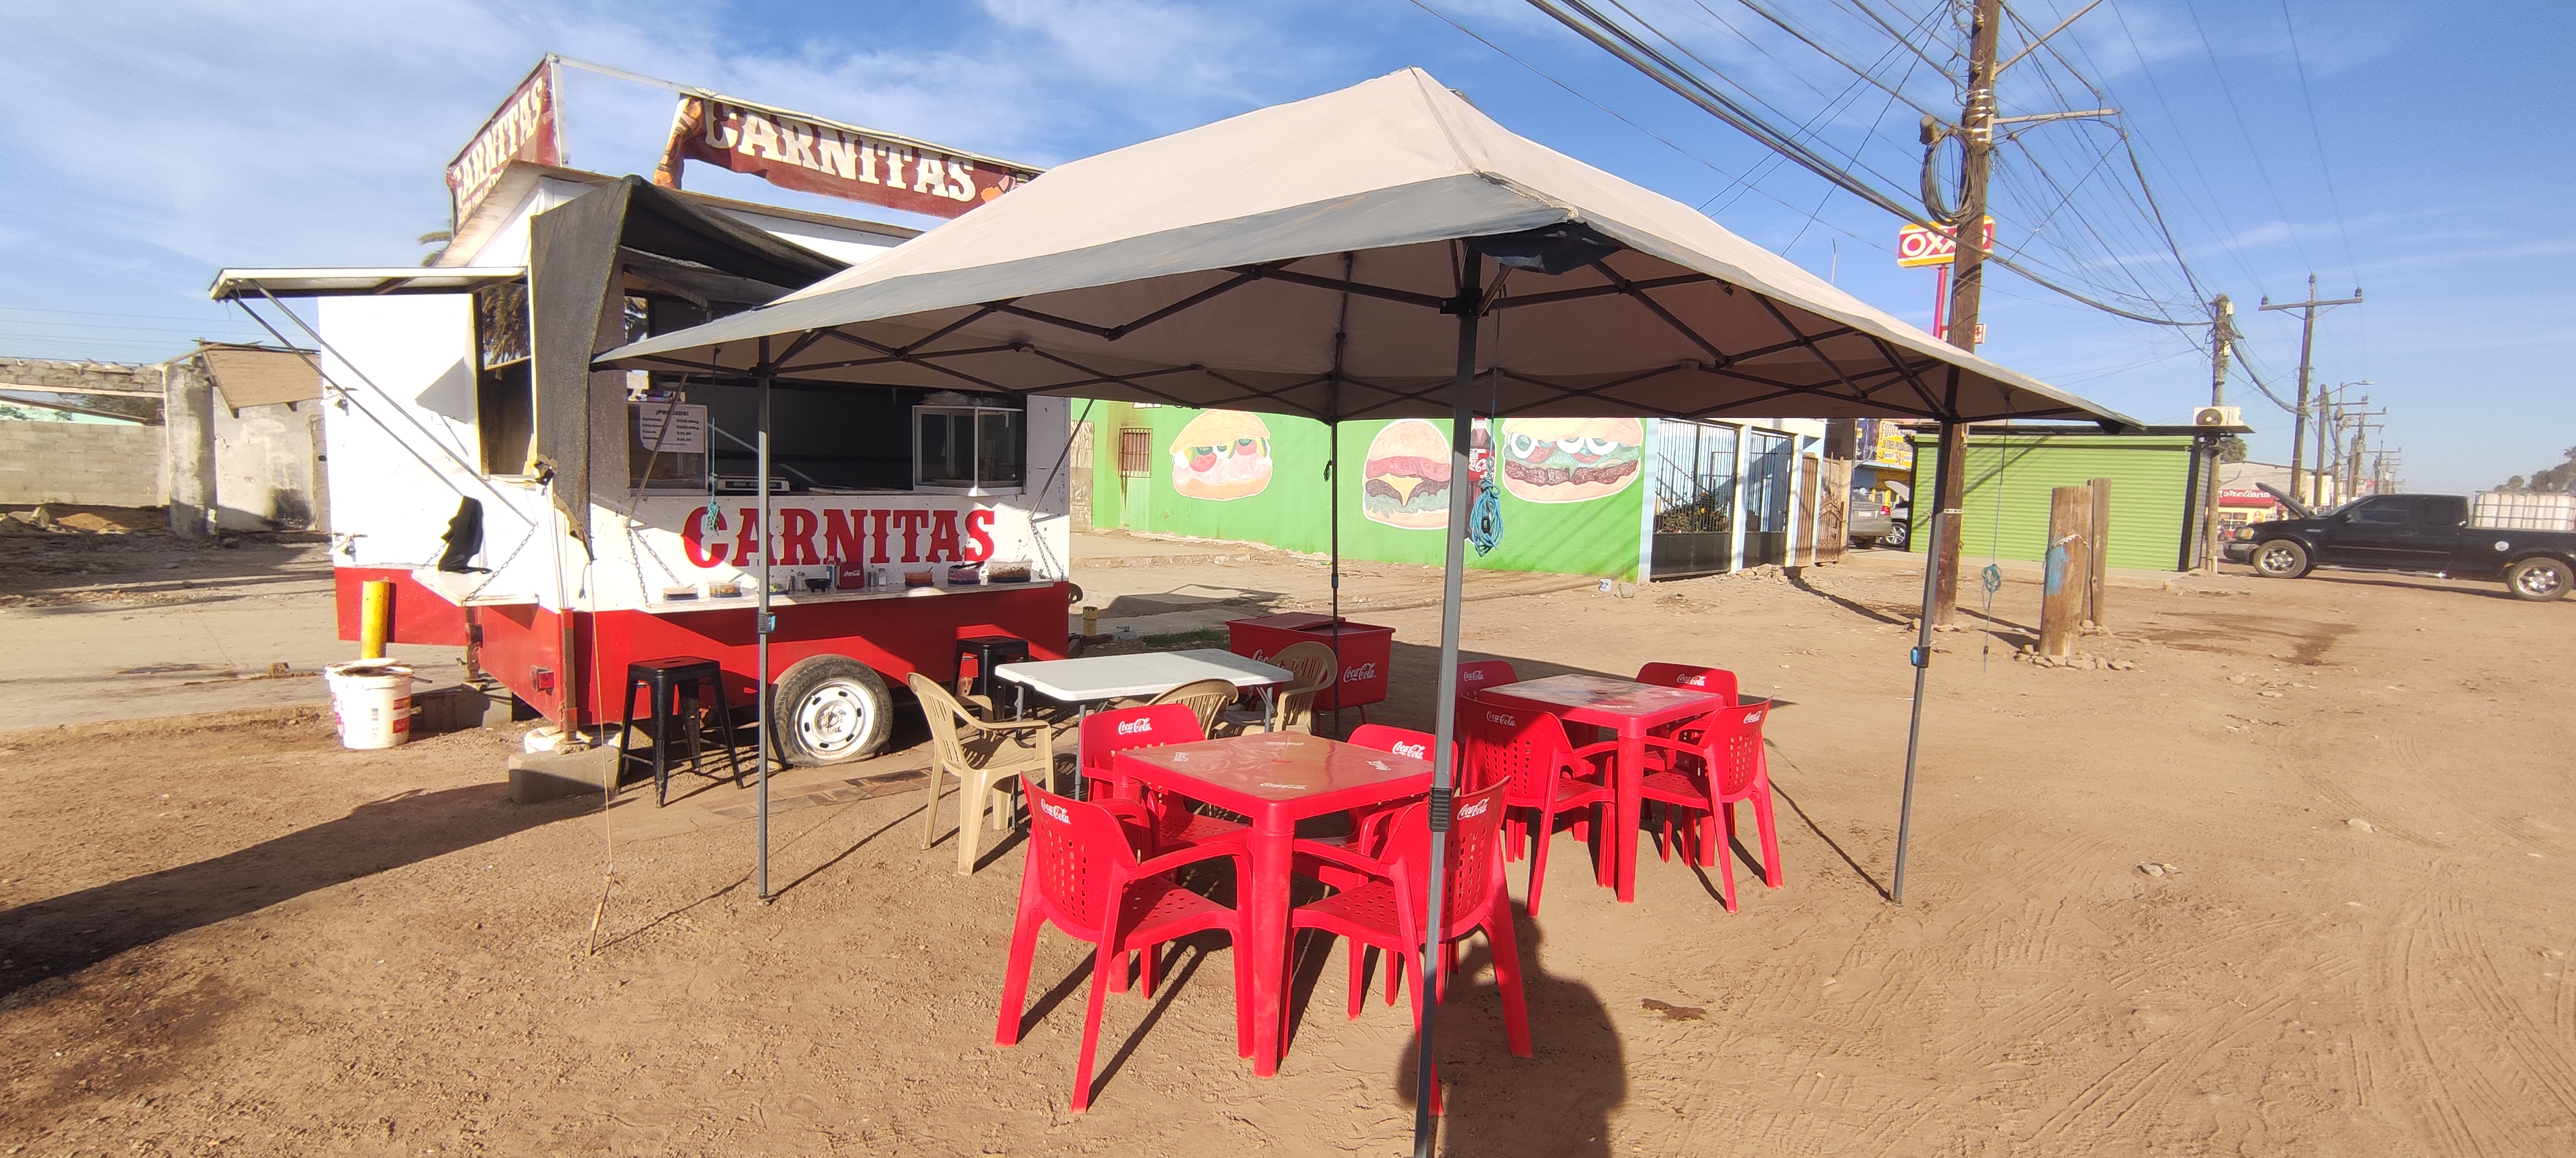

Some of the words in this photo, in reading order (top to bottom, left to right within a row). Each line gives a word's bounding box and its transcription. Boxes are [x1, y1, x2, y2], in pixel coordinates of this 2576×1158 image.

[705, 98, 976, 202] CARNITAS
[1901, 228, 1988, 256] OXX
[683, 506, 995, 569] CARNITAS
[1343, 662, 1377, 682] Coca-Cola
[1118, 717, 1153, 735] Coca-Cola
[1486, 711, 1516, 727] Coca-Cola
[1392, 741, 1426, 760] Coca-Cola
[1041, 798, 1072, 825] Coca-Cola
[1456, 796, 1491, 821] Coca-Cola
